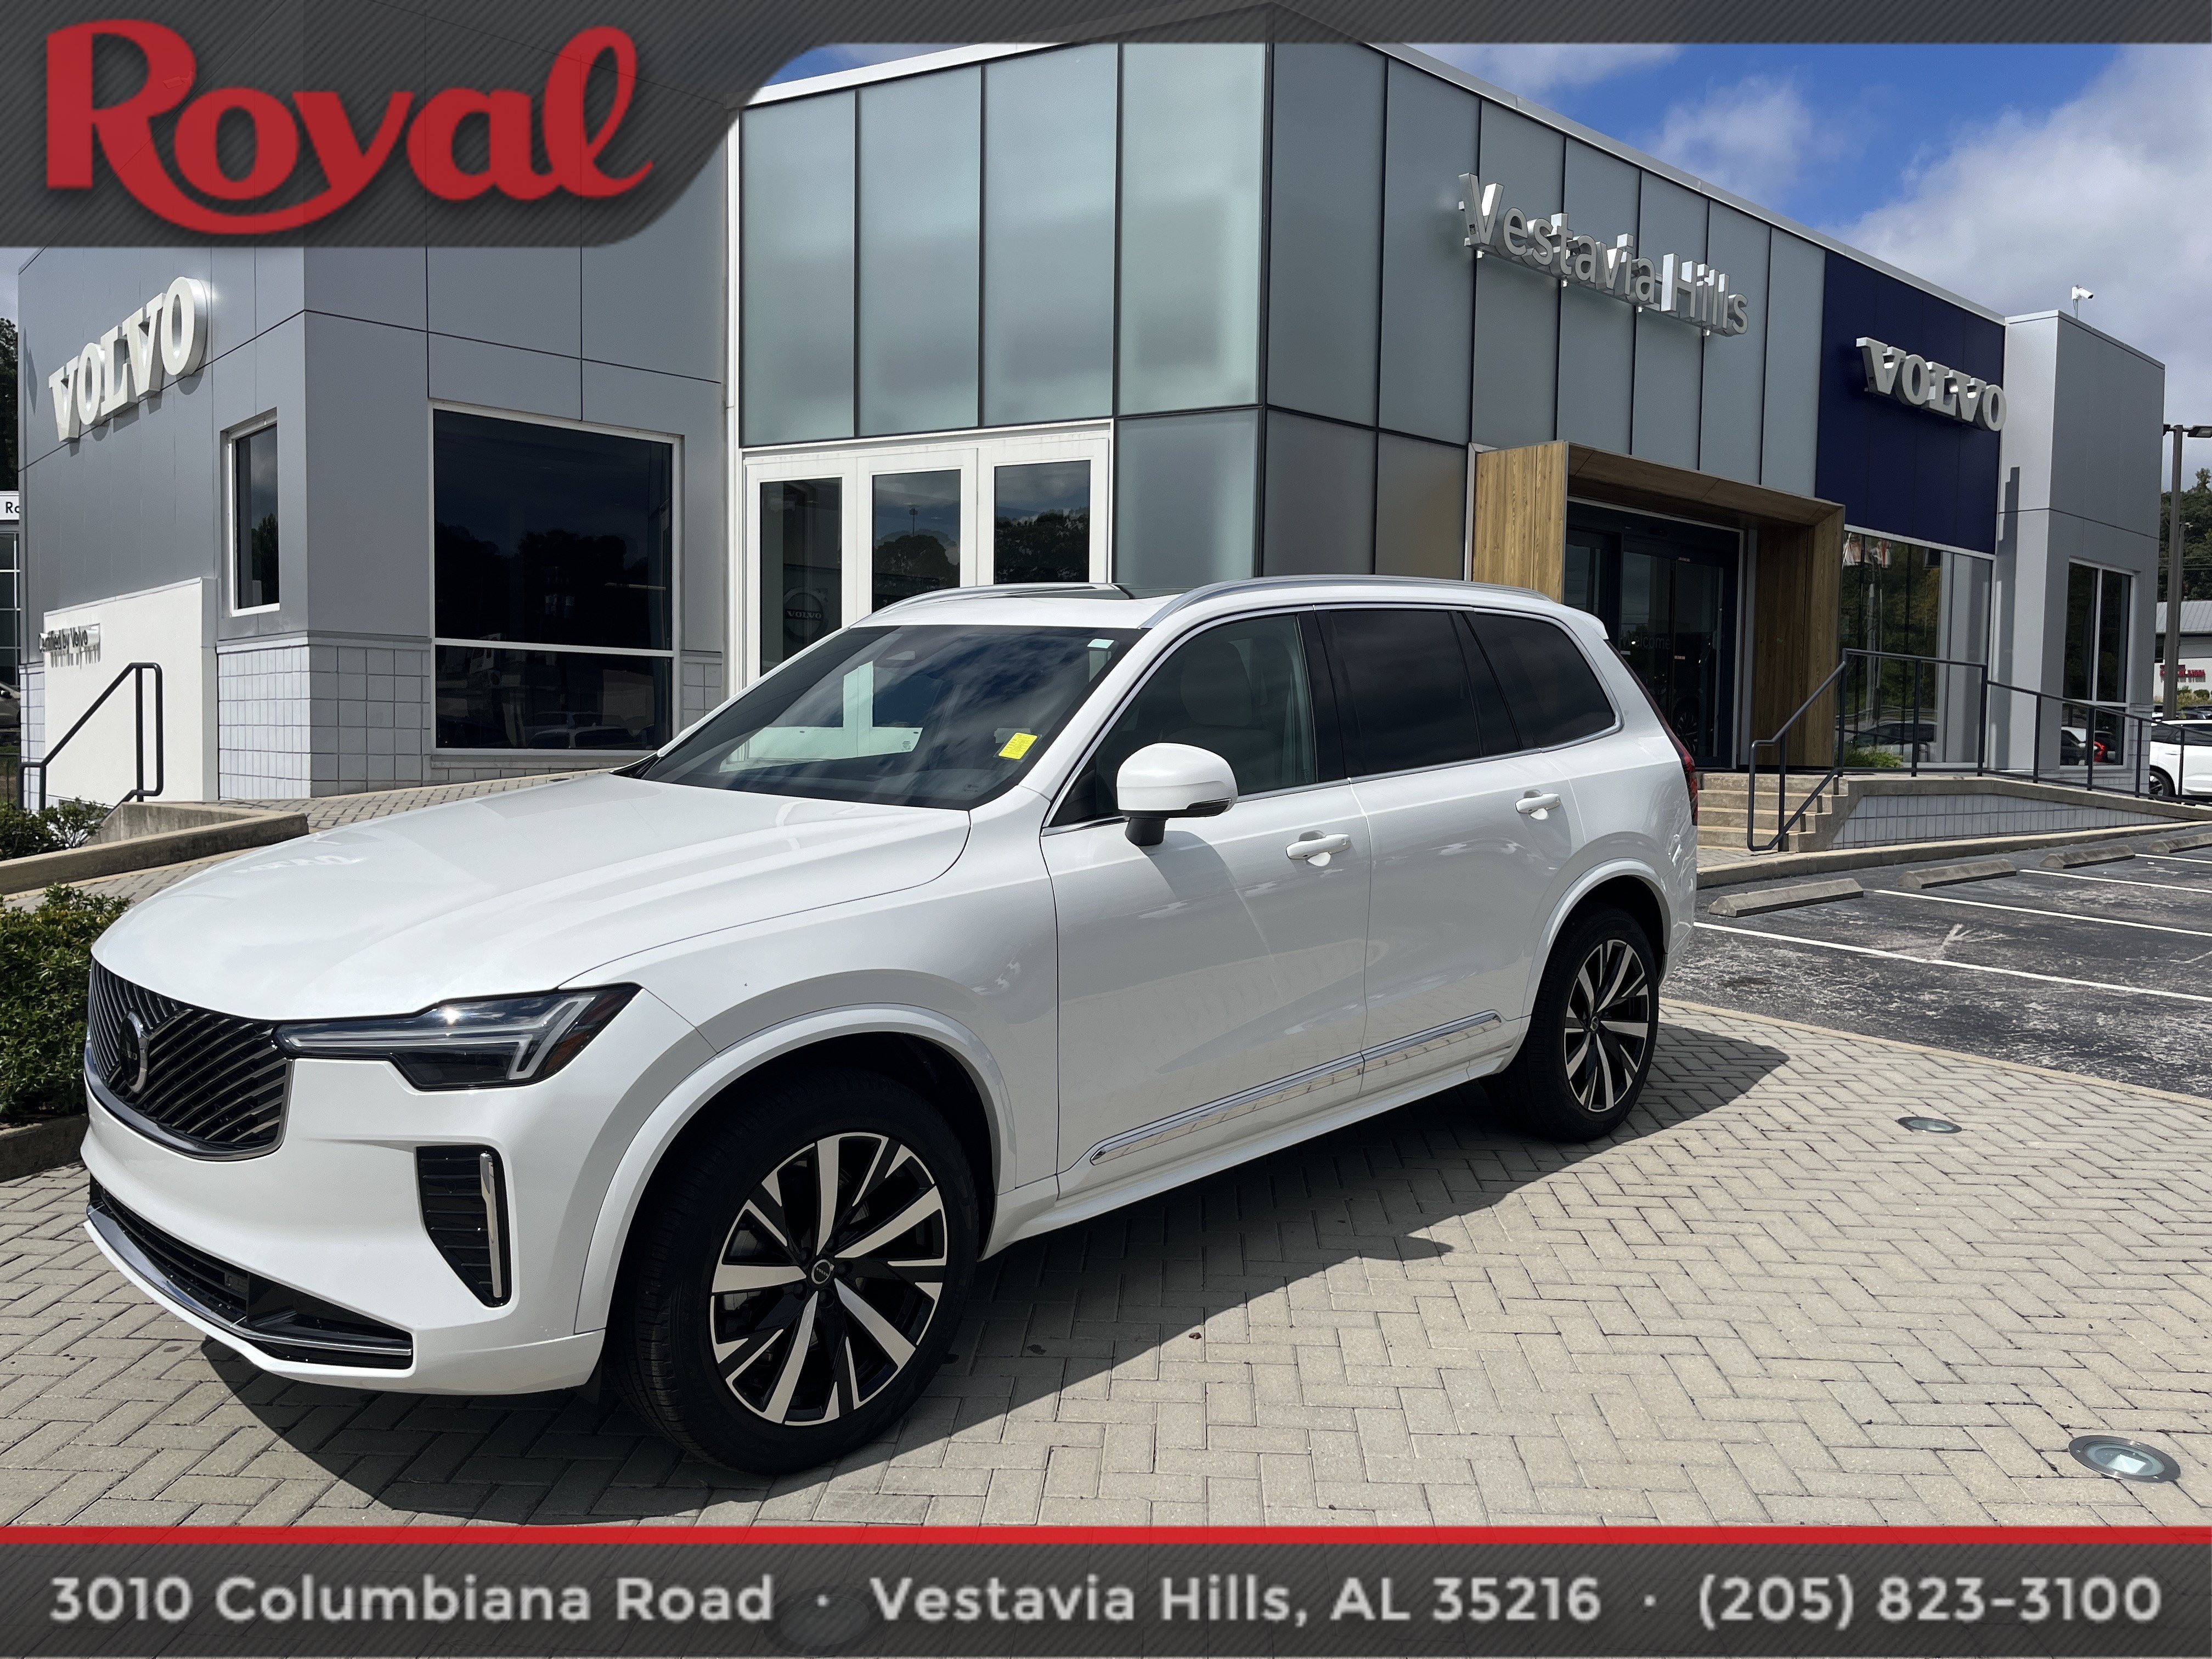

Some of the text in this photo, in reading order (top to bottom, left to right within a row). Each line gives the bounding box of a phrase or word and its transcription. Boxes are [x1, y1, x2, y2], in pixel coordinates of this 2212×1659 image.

[1459, 173, 1749, 336] Vestavia Hills
[48, 276, 208, 442] VOLVO
[1856, 337, 2007, 432] VOLVO
[70, 626, 88, 648] Volvo
[787, 610, 822, 619] VOLVO
[816, 1267, 829, 1277] VOLVO
